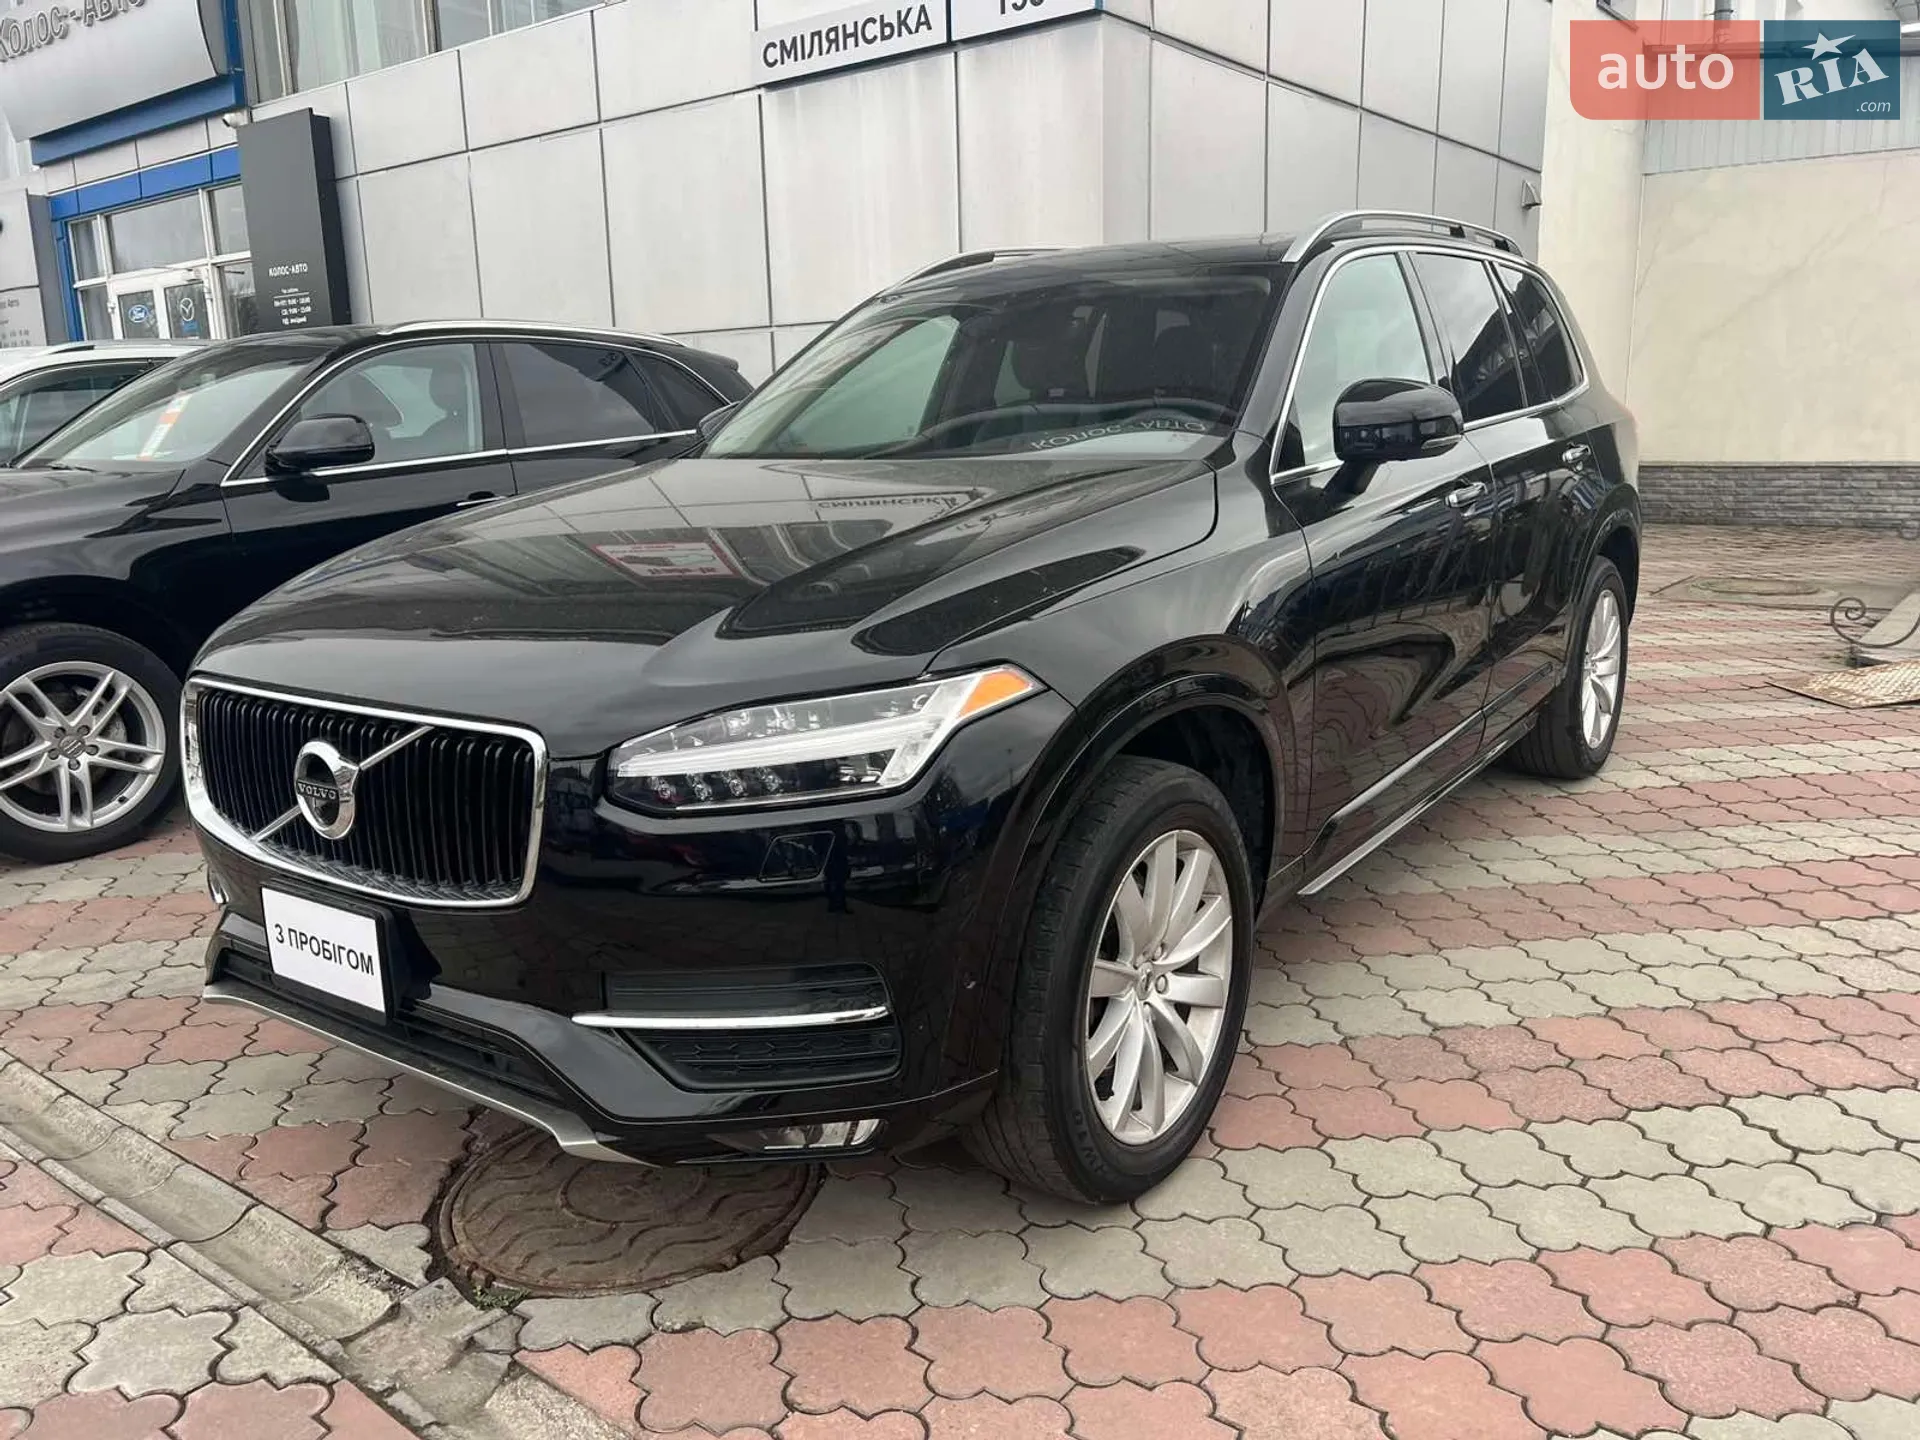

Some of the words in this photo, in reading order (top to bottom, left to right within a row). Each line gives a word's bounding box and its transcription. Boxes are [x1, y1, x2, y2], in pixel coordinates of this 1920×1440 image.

[762, 4, 933, 69] СМІЛЯНСЬКА
[297, 782, 337, 800] VOLVO
[288, 927, 375, 976] ПРОБІГОМ
